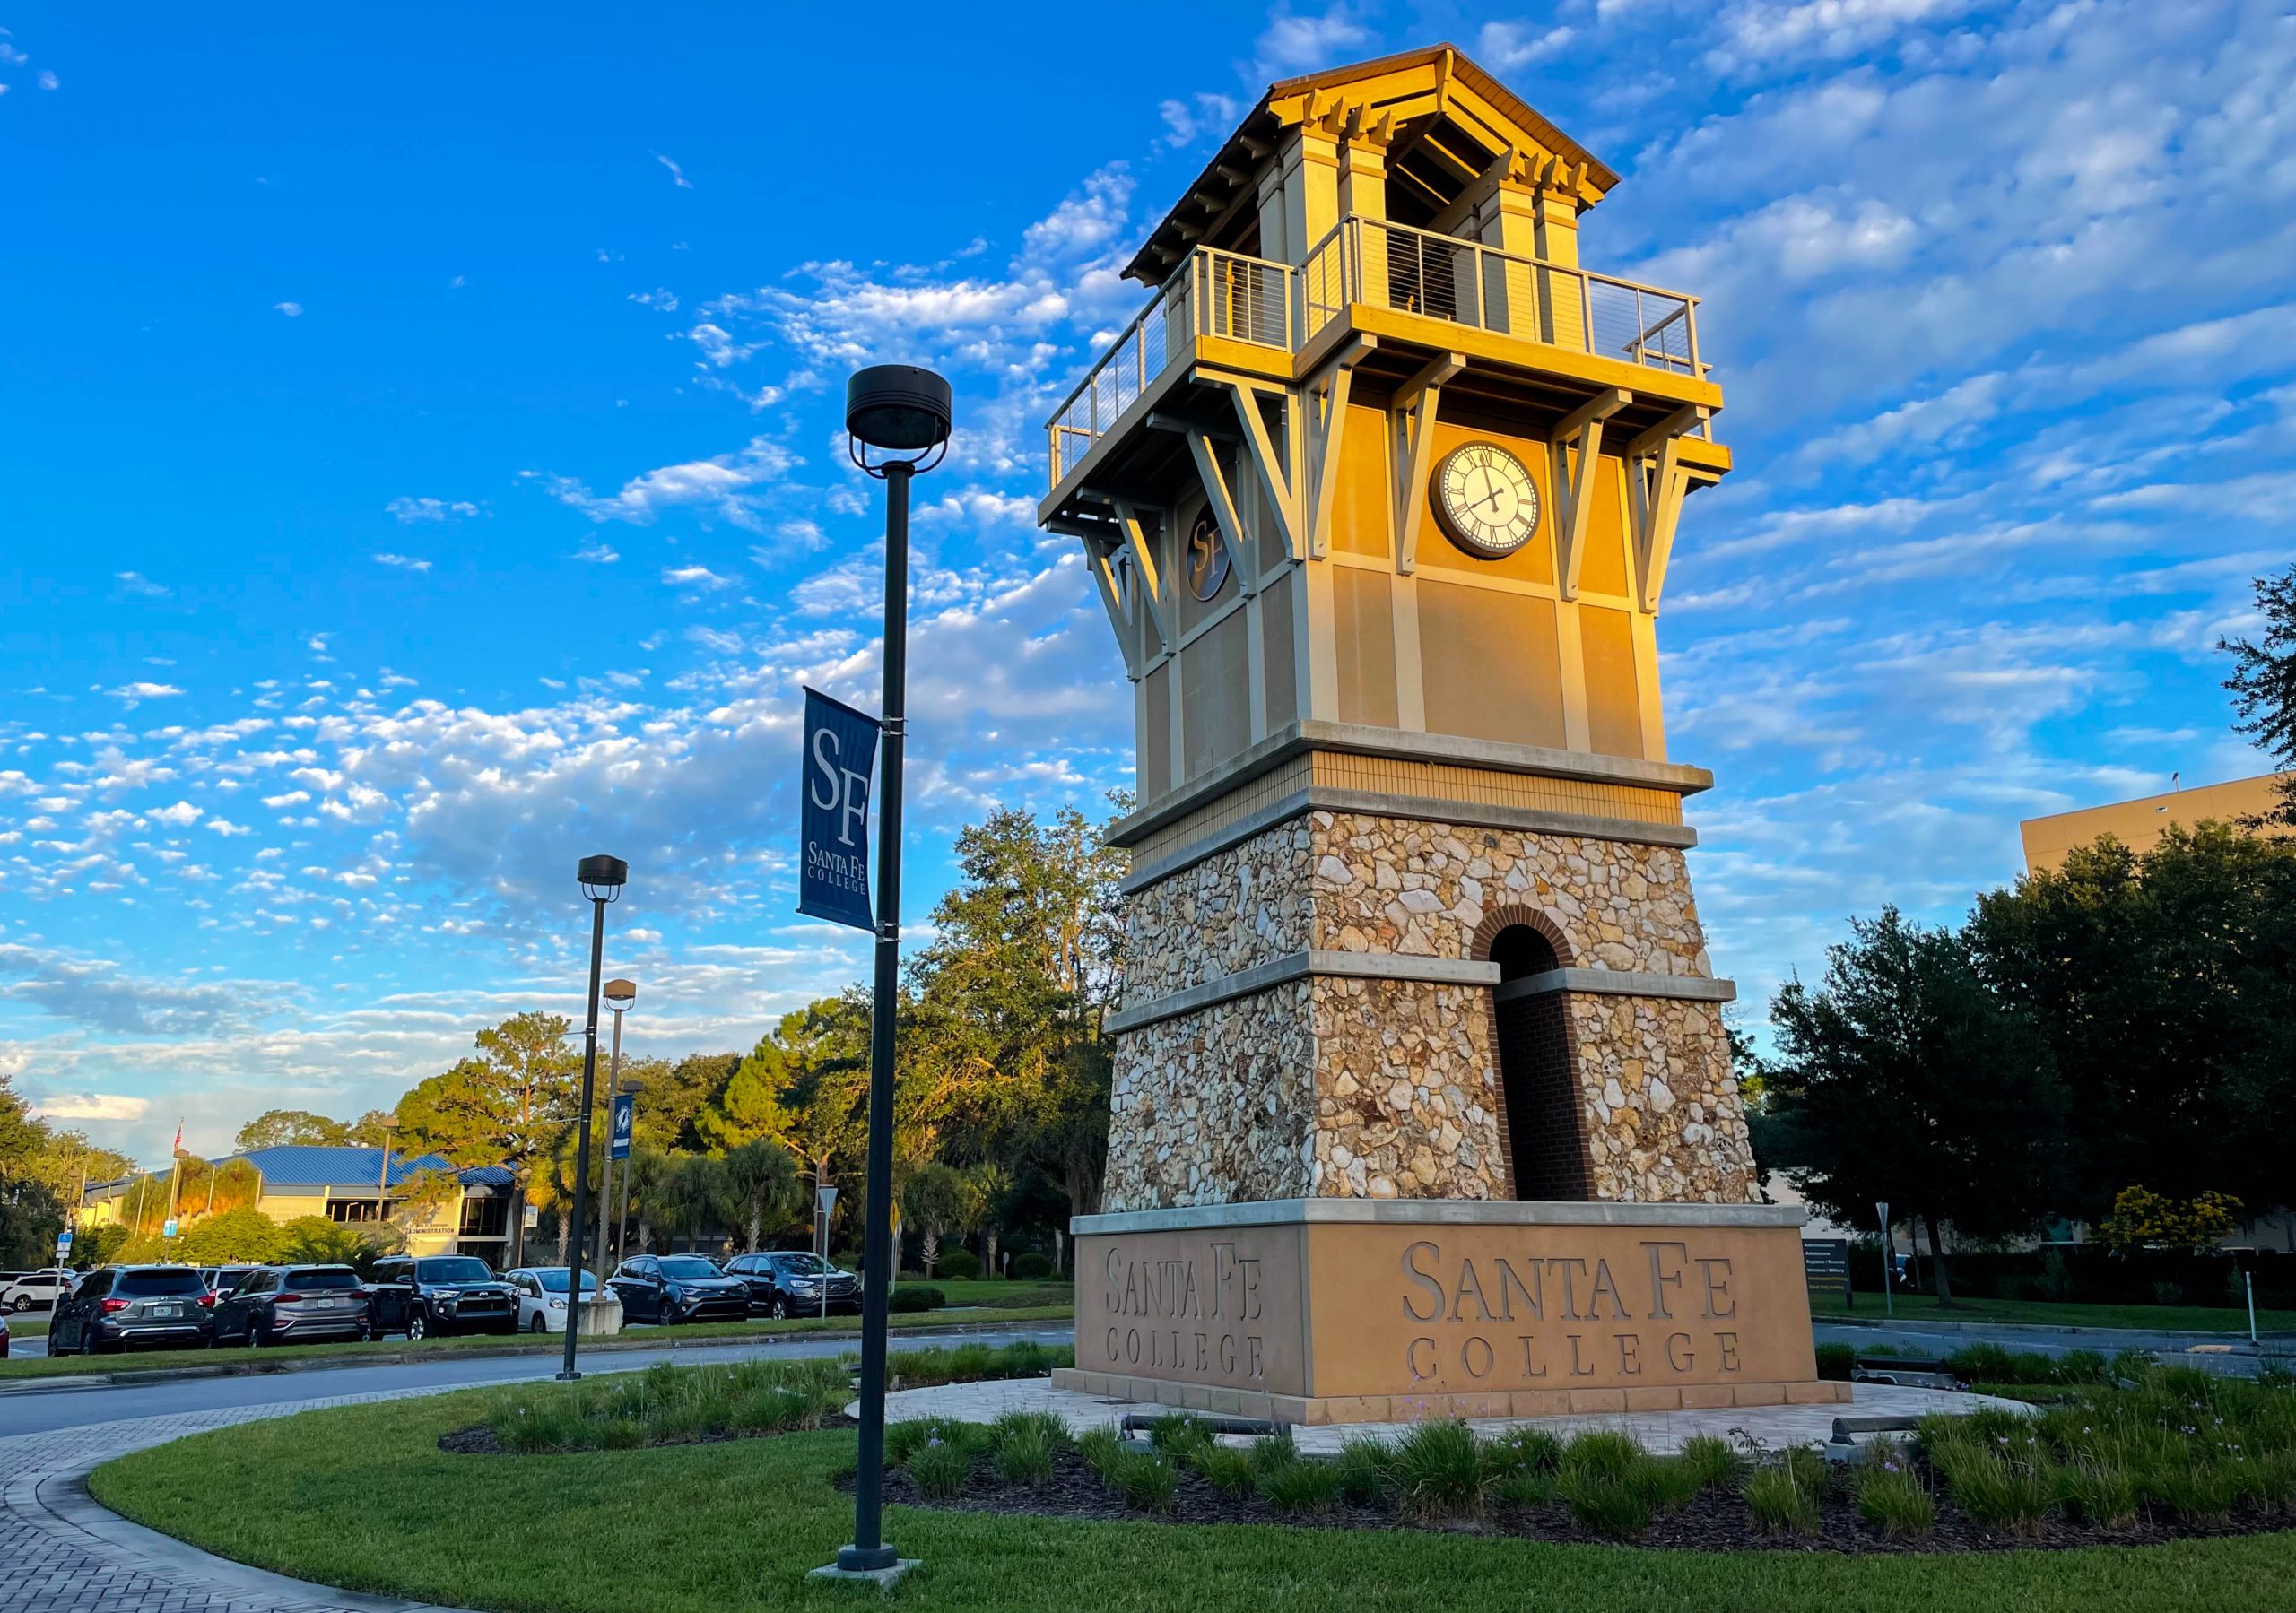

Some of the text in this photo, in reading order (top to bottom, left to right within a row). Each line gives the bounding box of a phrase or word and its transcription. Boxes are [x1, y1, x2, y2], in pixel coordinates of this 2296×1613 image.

[1451, 465, 1467, 480] X
[1512, 478, 1526, 486] II
[1194, 520, 1223, 579] SF
[812, 728, 868, 846] SF
[808, 869, 865, 895] COLLEGE
[809, 840, 865, 881] SANTA FE
[1106, 1243, 1261, 1321] SANTA FE
[1402, 1241, 1736, 1323] SANTA FE
[1107, 1327, 1264, 1377] COLLEGE
[1407, 1332, 1740, 1379] COLLEGE
